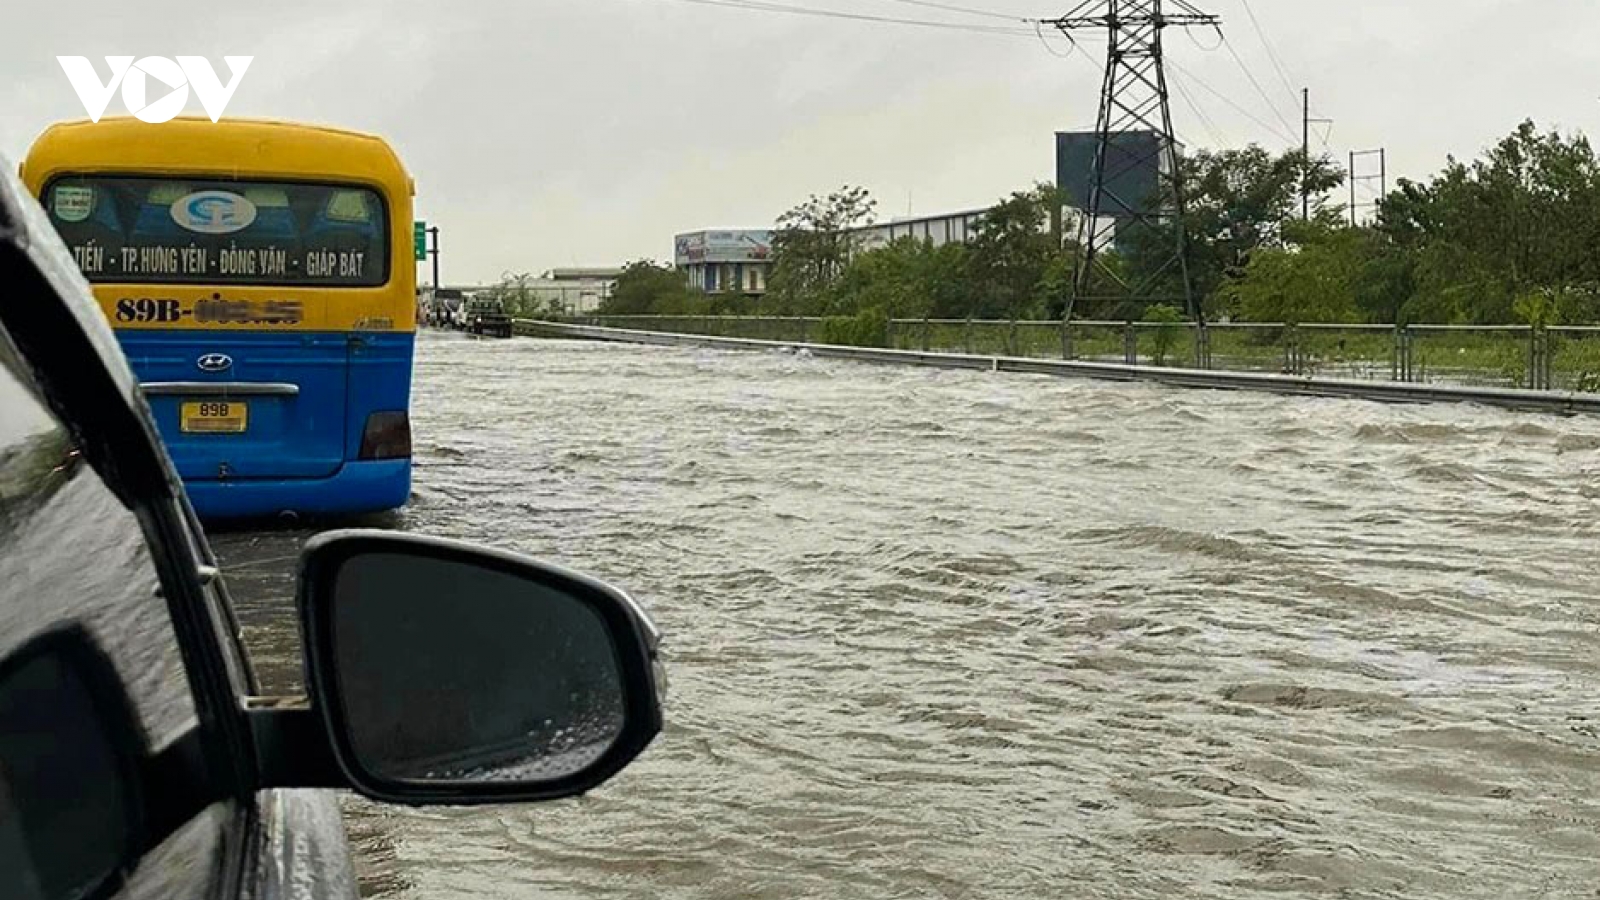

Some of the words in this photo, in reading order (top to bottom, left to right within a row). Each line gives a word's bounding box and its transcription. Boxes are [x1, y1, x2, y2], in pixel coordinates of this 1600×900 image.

[74, 239, 103, 272] TIẾN
[180, 243, 207, 274] YÊN
[258, 245, 286, 275] VĂN
[306, 247, 337, 276] GIÁP
[340, 248, 364, 276] BÁT
[200, 403, 229, 417] 89B
